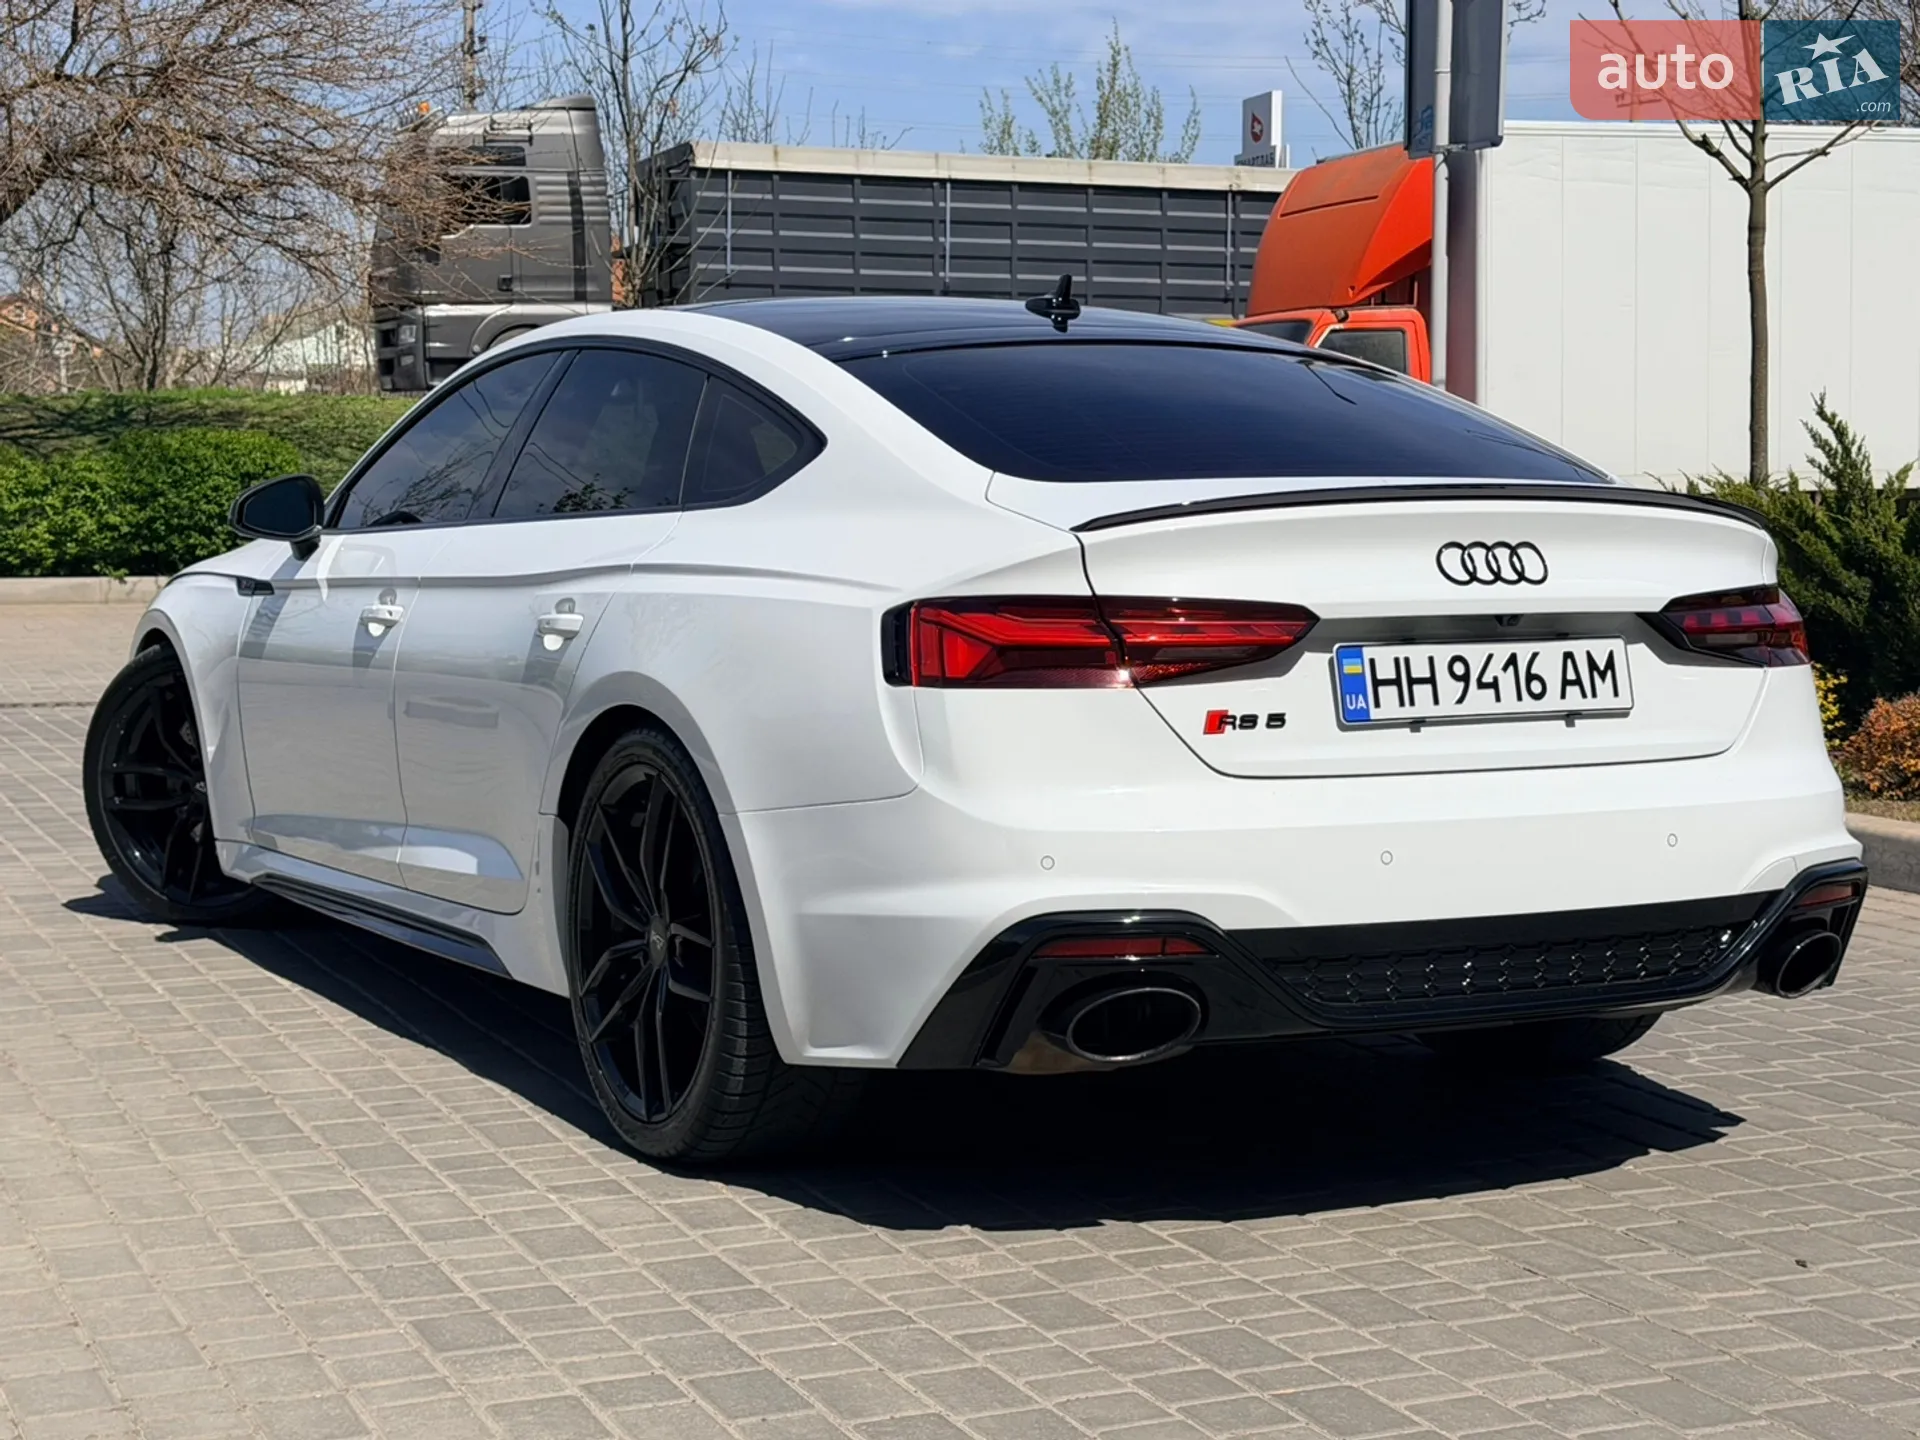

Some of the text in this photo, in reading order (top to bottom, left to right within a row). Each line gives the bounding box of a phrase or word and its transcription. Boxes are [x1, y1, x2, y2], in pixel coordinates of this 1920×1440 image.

[1346, 694, 1367, 710] UA
[1217, 712, 1287, 731] RS 5
